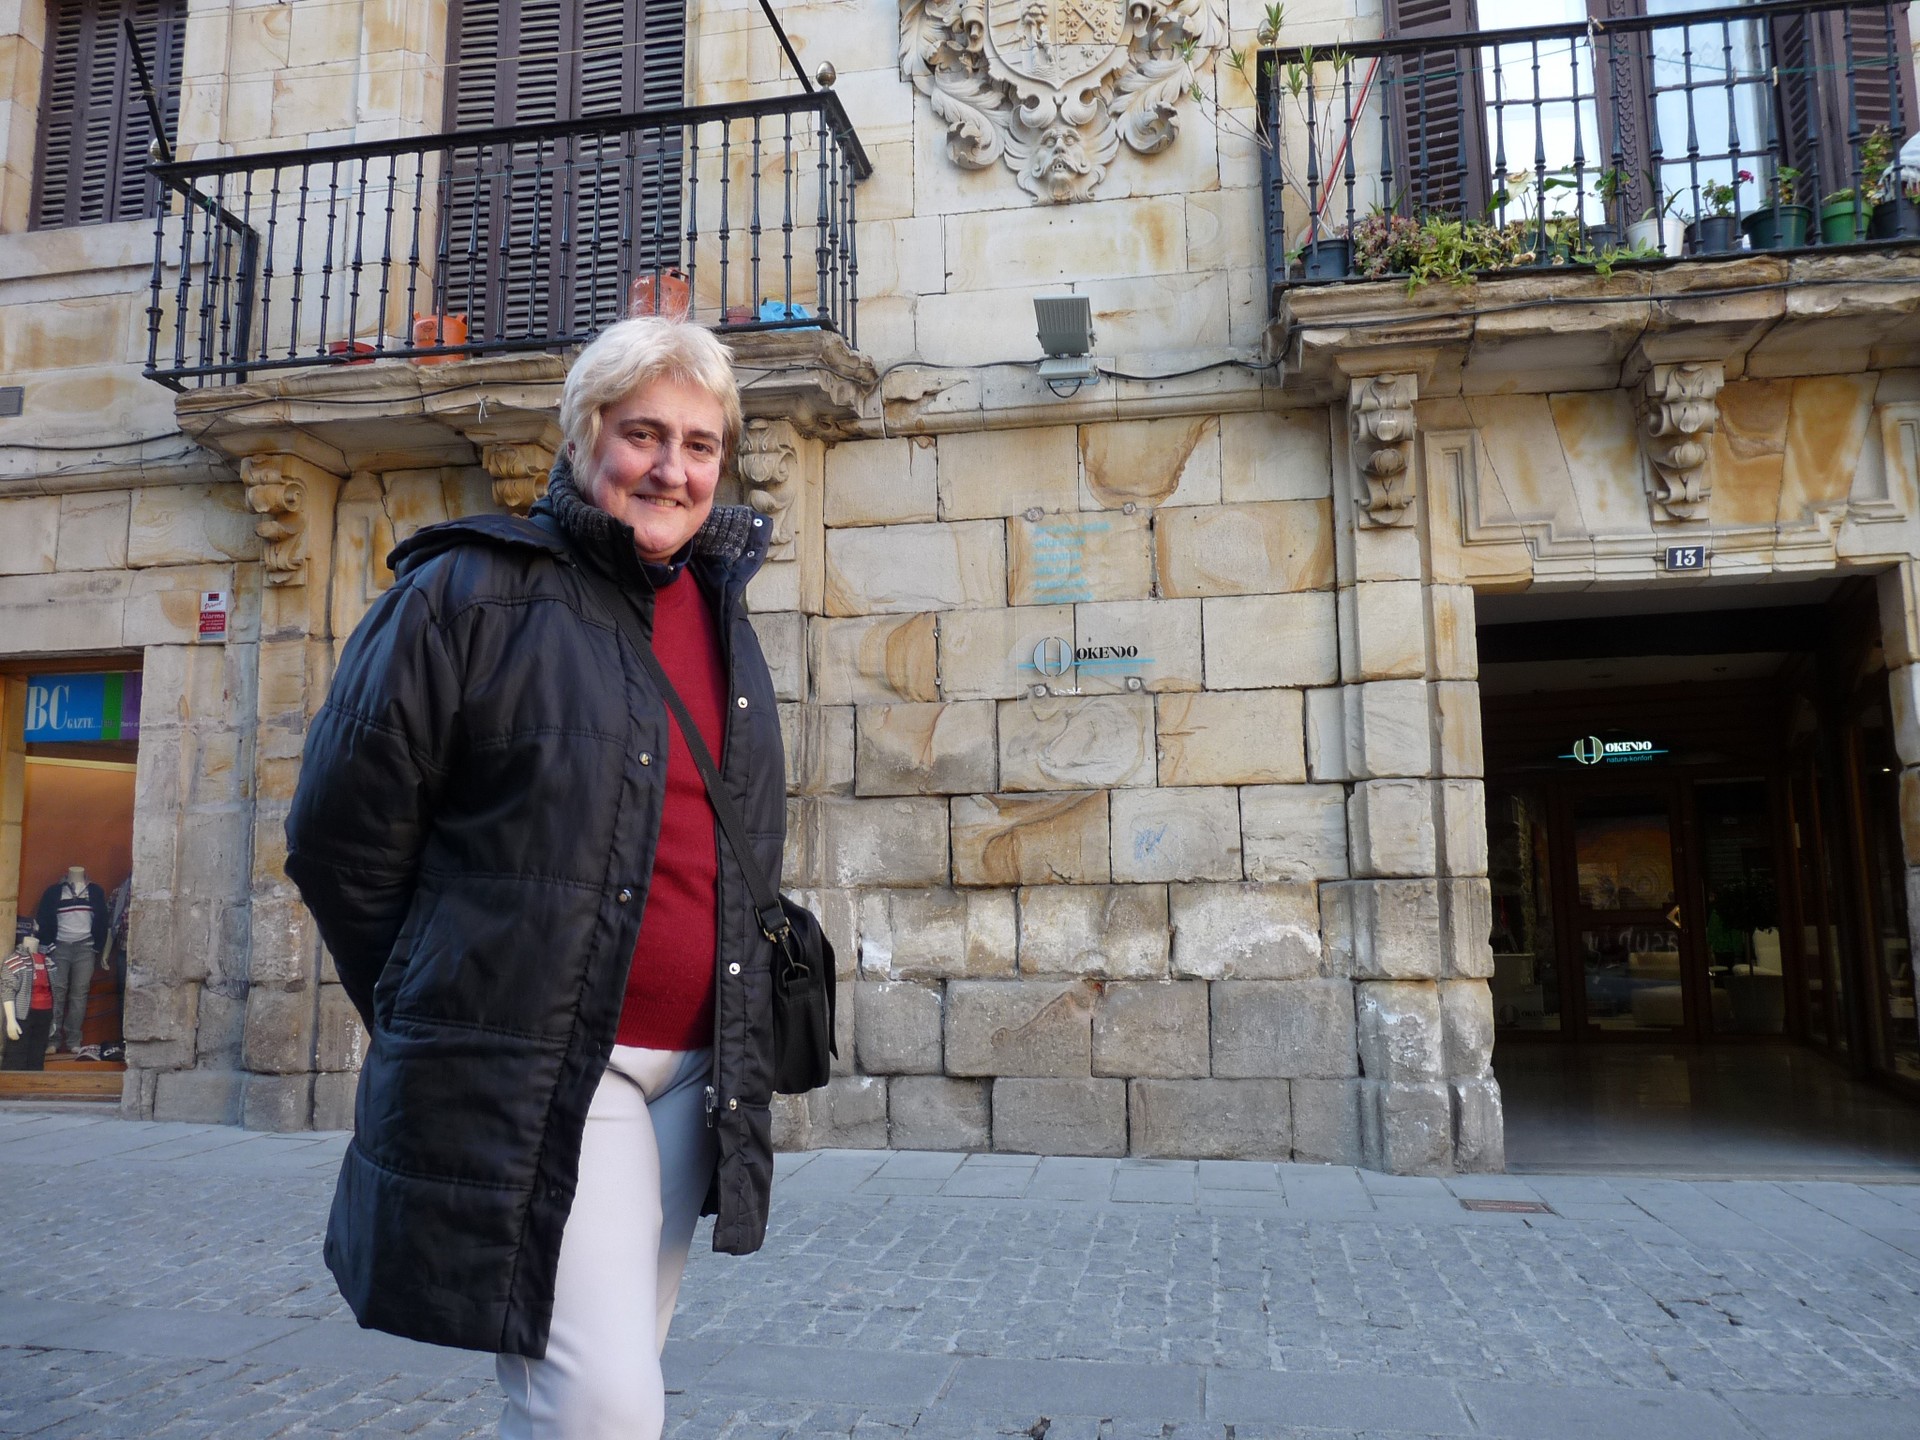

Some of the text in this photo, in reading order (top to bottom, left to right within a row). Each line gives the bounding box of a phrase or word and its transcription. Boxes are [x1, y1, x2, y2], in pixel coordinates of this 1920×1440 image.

[1675, 549, 1697, 567] 13
[1076, 645, 1138, 660] OKENDO
[24, 684, 70, 731] BC
[1605, 740, 1652, 753] OKENDO
[1606, 754, 1653, 763] natura-konfort
